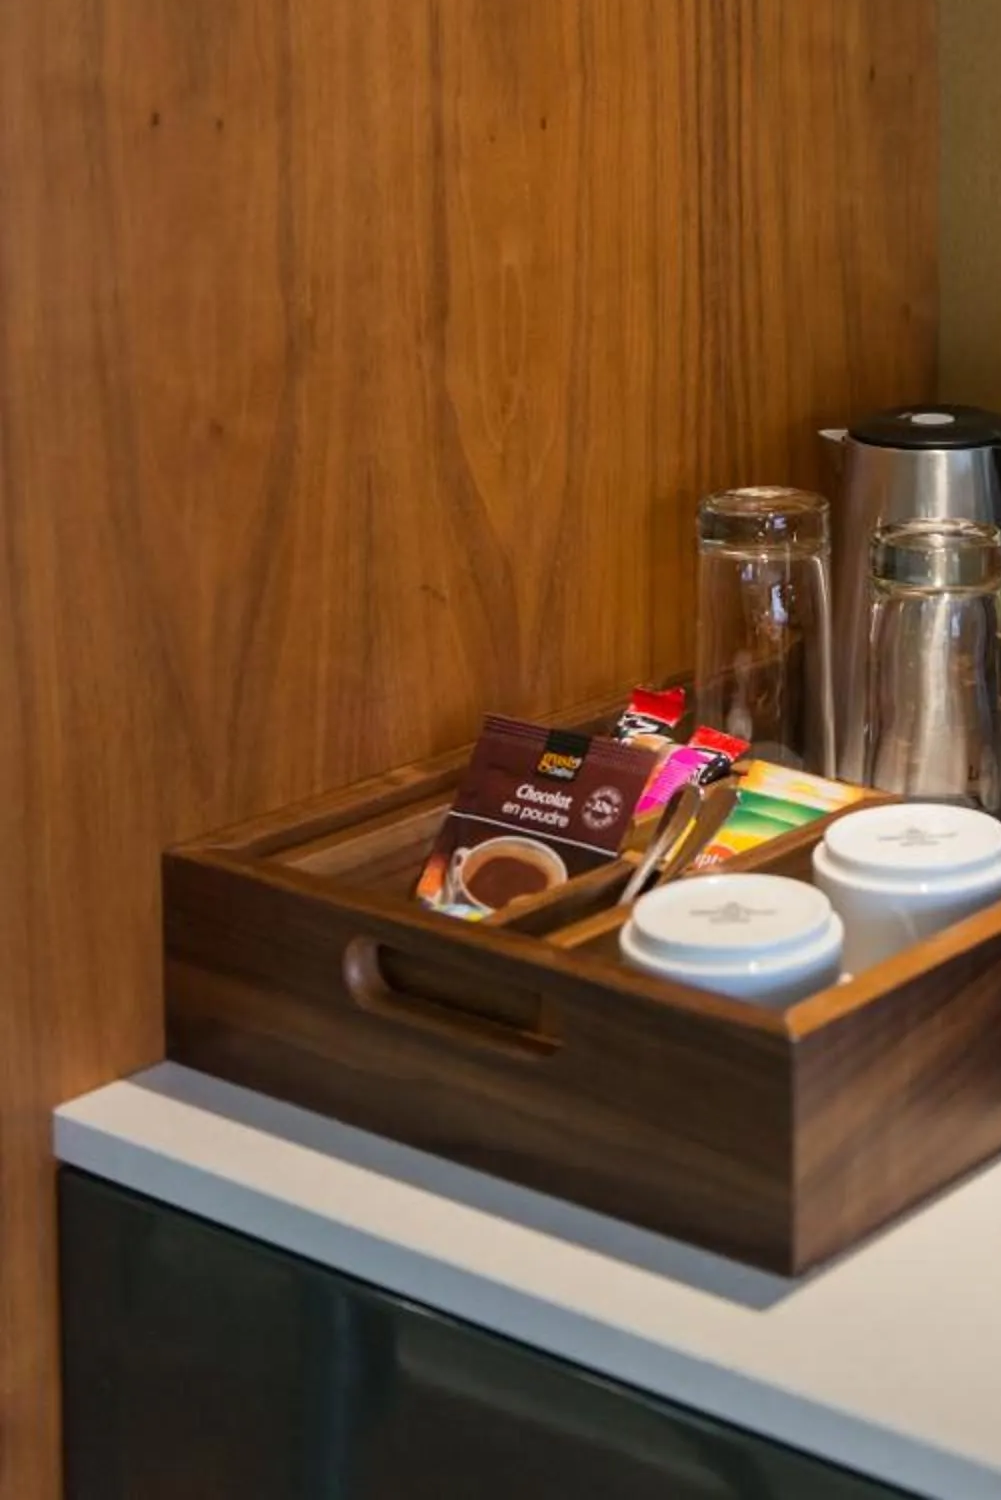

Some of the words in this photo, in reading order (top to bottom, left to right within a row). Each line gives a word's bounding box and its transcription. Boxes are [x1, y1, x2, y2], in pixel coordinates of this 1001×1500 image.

[516, 783, 573, 810] Chocolat
[501, 801, 520, 816] en
[520, 807, 569, 829] poudre
